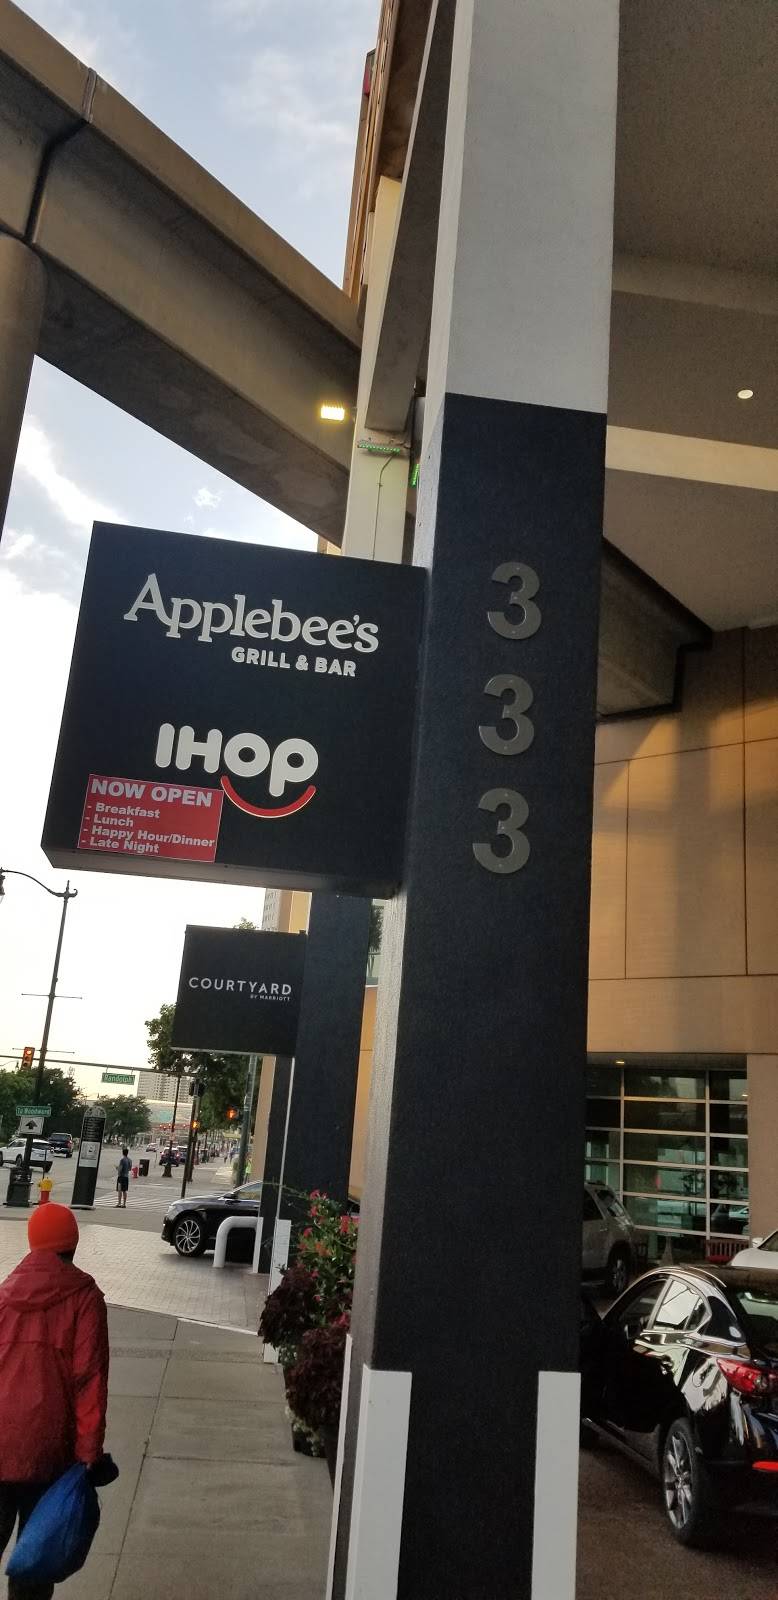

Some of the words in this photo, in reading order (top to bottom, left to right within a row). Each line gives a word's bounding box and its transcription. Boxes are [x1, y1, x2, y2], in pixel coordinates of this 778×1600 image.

[123, 572, 379, 653] Applebee's
[231, 646, 291, 669] GRILL
[295, 654, 309, 671] &
[314, 656, 357, 677] BAR
[91, 778, 146, 799] NOW
[151, 786, 212, 807] OPEN
[95, 802, 160, 818] Breakfast
[93, 814, 134, 827] Lunch
[91, 825, 134, 840] Happy
[137, 830, 215, 847] Hour/Dinner
[89, 837, 119, 849] Late
[123, 840, 160, 854] Night
[188, 977, 292, 995] COURTYARD
[259, 994, 291, 1002] MARRIOTT
